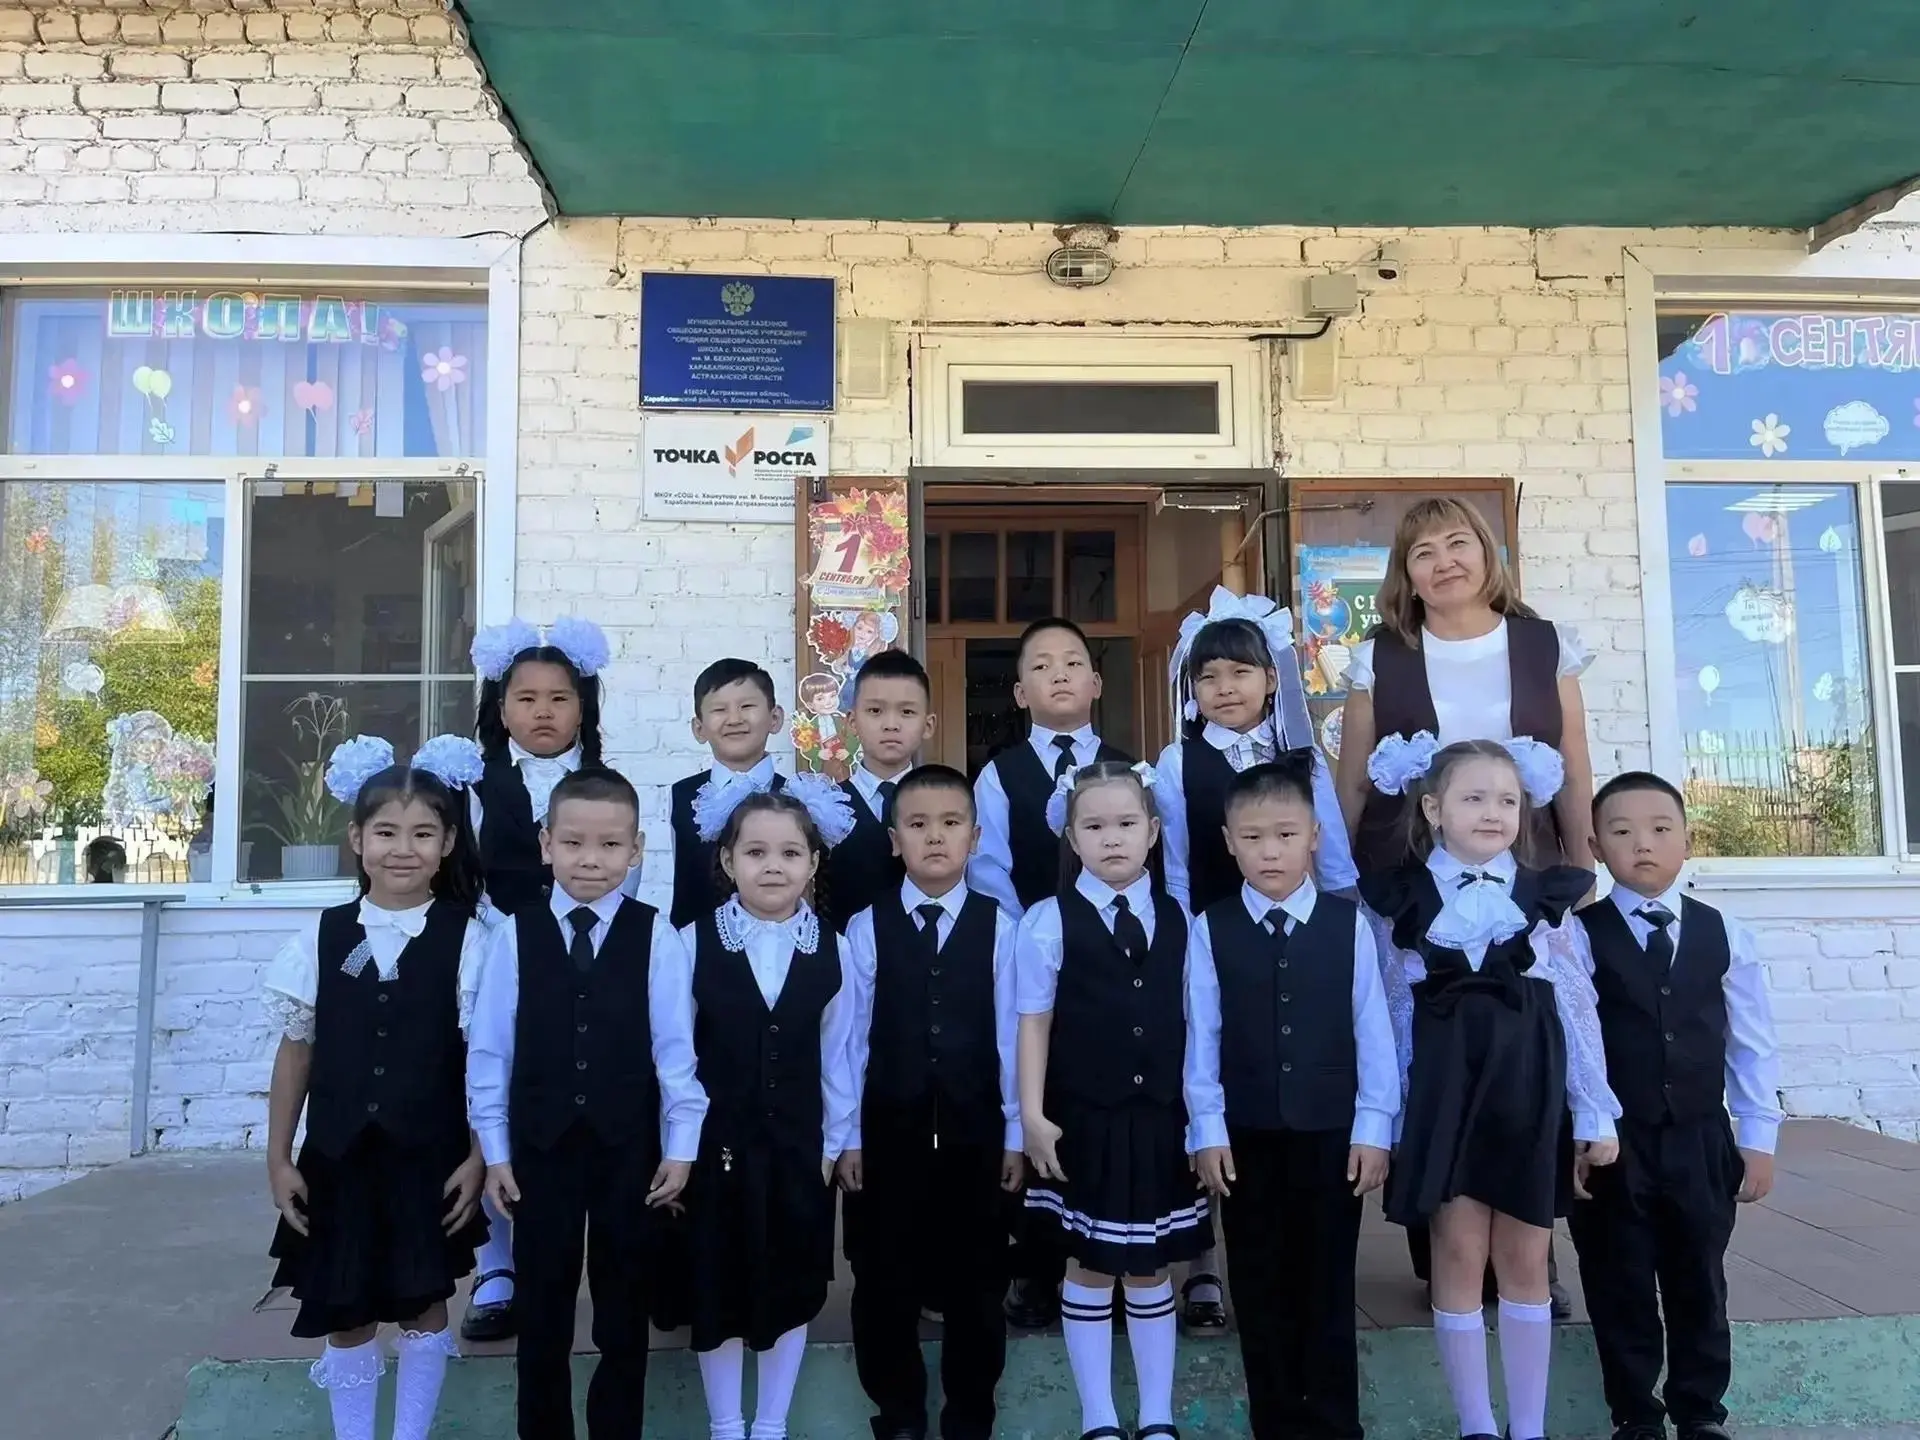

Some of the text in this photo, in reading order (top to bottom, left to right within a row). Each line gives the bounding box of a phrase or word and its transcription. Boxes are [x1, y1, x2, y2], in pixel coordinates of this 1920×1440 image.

[108, 290, 379, 344] ШКОЛА!
[687, 318, 788, 328] МУНИЦИПАЛЬНОЕ КАЗЕННОЕ
[666, 327, 808, 338] ОБЩЕОБРАЗОВАТЕЛЬНОЕ УЧРЕЖДЕНИЕ
[710, 337, 802, 346] ОБЩЕОБРАЗОВАТЕЛЬНАЯ
[1692, 312, 1920, 374] 1 СЕНТЯ
[688, 363, 785, 373] ХАРАБАЛИНСКОГО РАЙОНА
[691, 372, 783, 382] АСТРАХАНСКОЙ ОБЛАСТИ
[653, 449, 817, 466] ТОЧКА РОСТА
[834, 533, 862, 572] 1
[819, 572, 865, 584] СЕНТЯБРЯ
[1354, 594, 1365, 611] С
